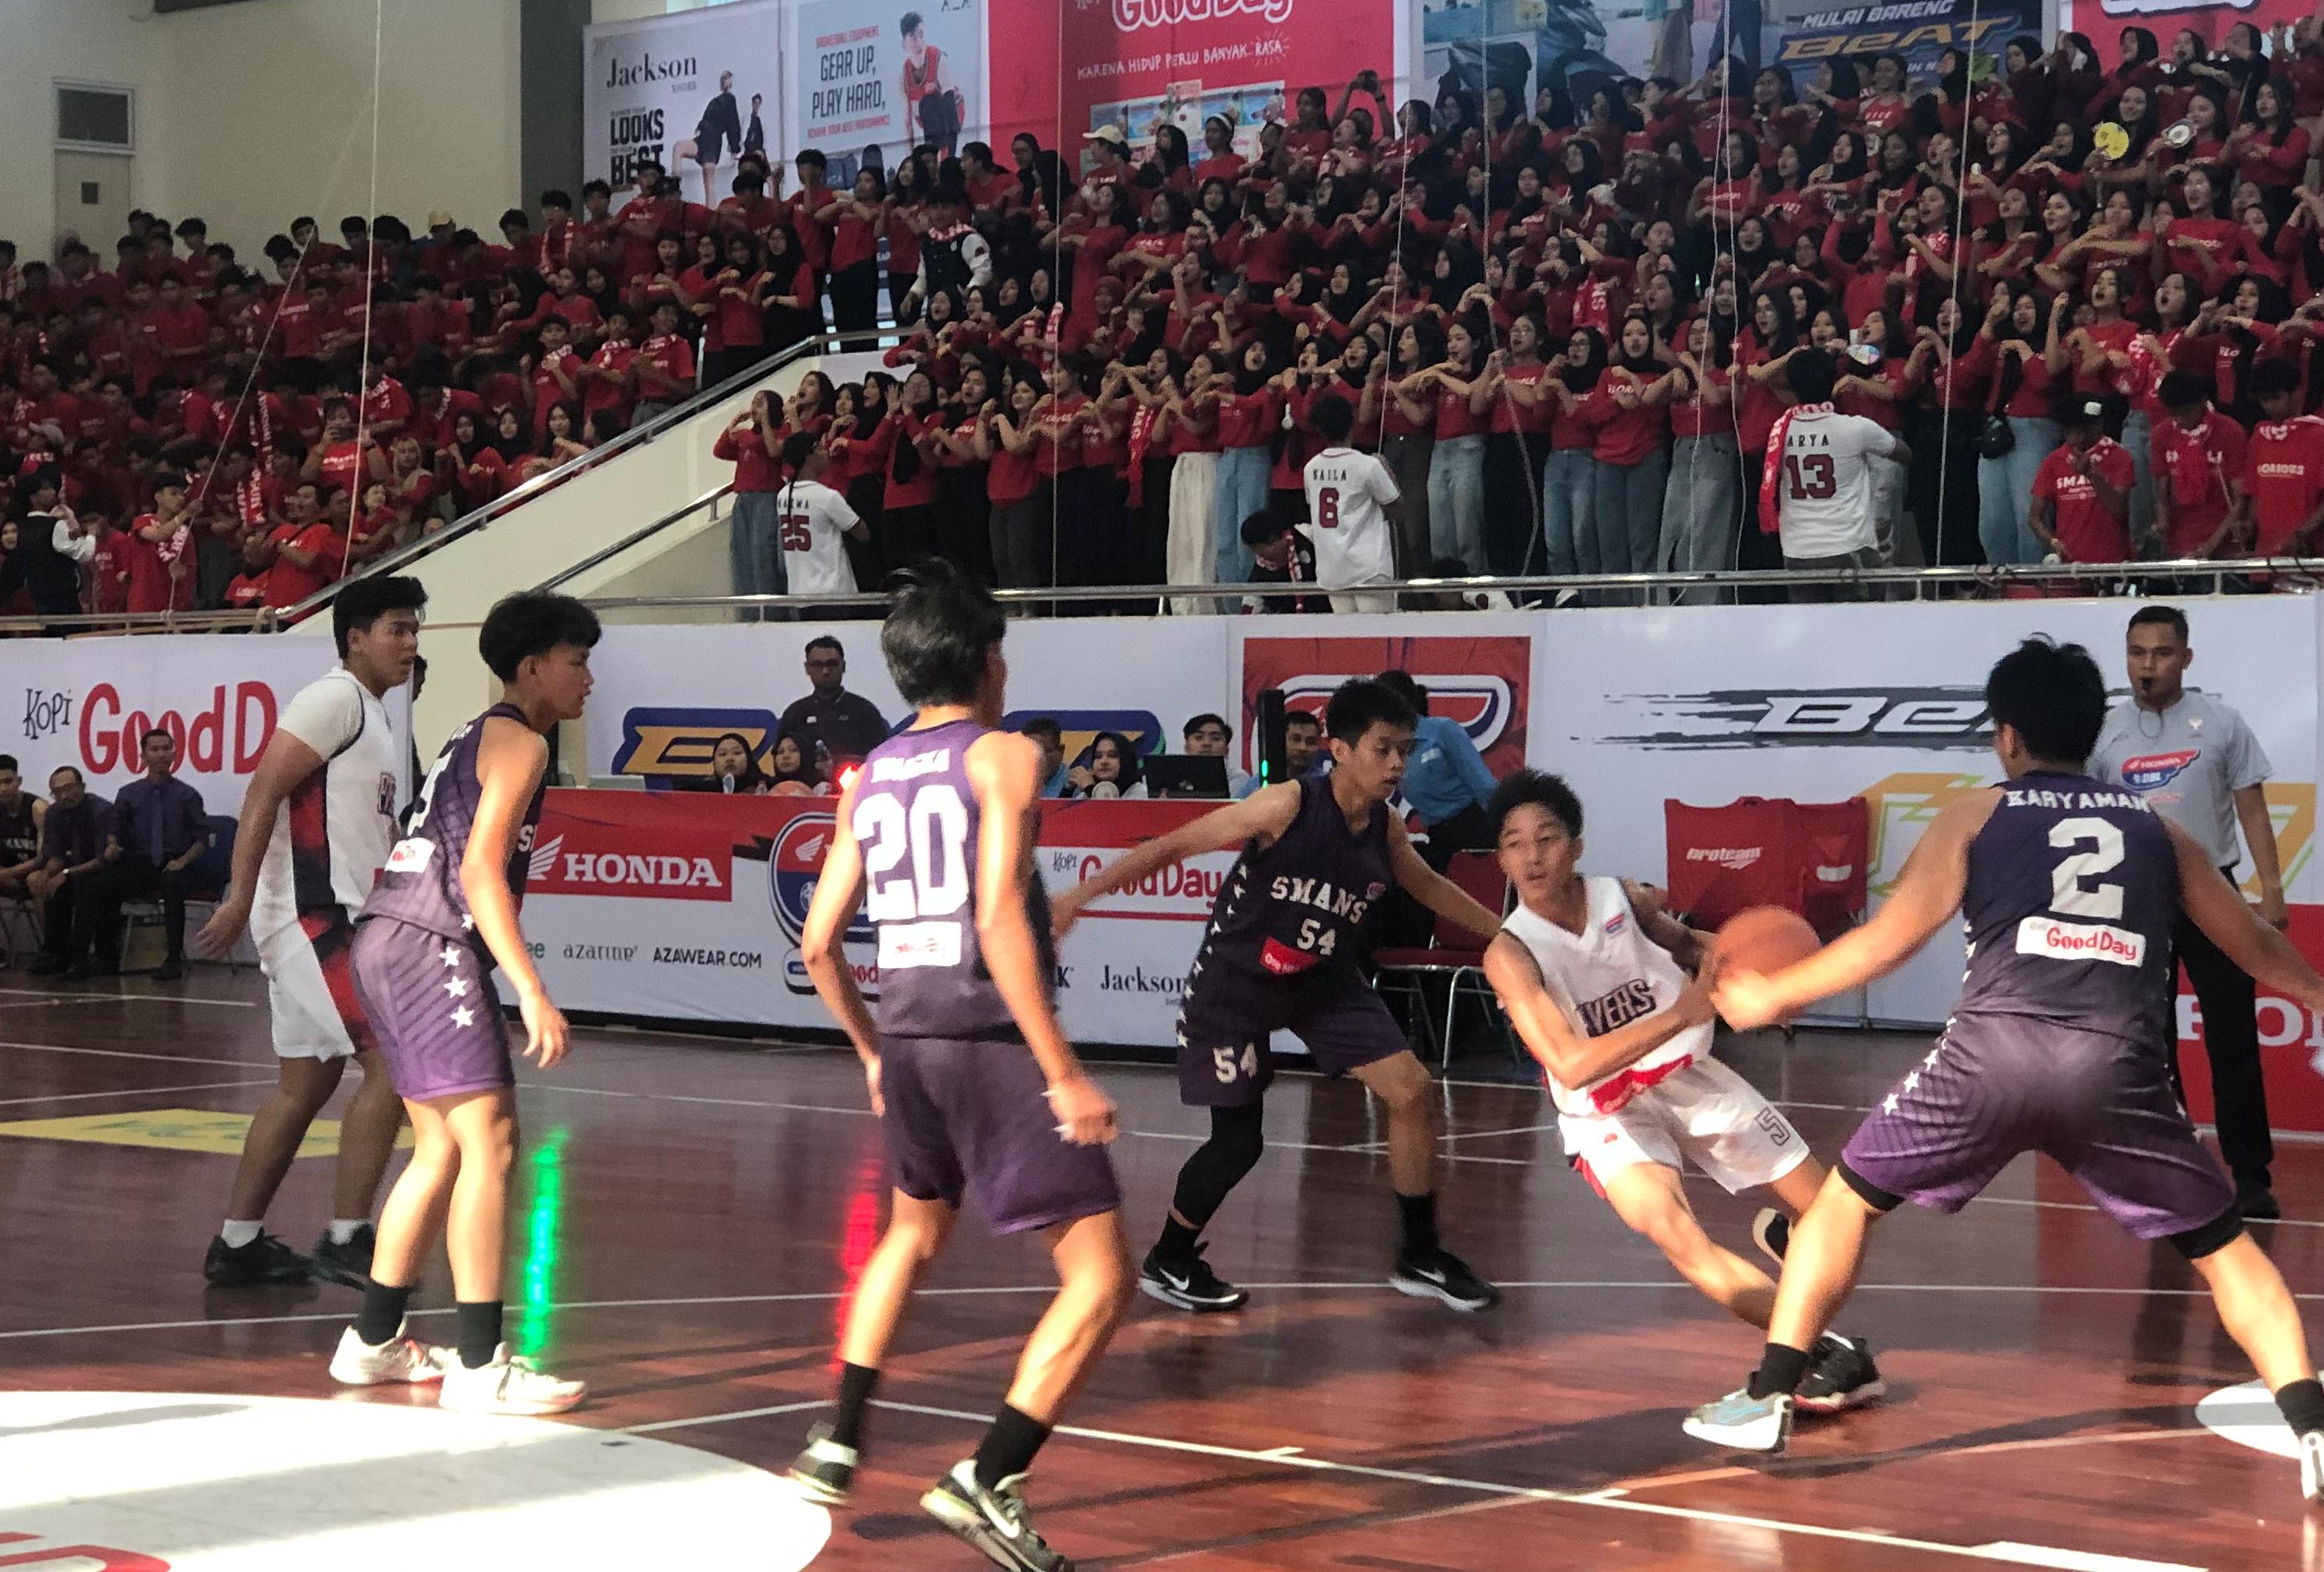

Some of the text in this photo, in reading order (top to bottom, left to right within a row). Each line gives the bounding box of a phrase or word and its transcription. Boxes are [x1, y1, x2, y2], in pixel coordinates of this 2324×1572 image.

[1801, 0, 1954, 29] MULAI BARENG
[606, 53, 698, 88] Jackson
[820, 44, 876, 81] GEAR UP,
[1077, 40, 1284, 79] KARENA HIDUP PERLU BANYAK RASA
[812, 80, 887, 119] PLAY HARD,
[610, 108, 664, 146] LOOKS
[1787, 434, 1830, 447] ARYA
[1785, 453, 1837, 500] 13
[1319, 487, 1339, 528] 6
[780, 514, 812, 552] 25
[563, 852, 723, 887] HONDA
[852, 784, 969, 922] 20
[2048, 817, 2125, 920] 2
[1270, 875, 1368, 924] SMANS
[1296, 918, 1337, 956] 54
[1212, 1042, 1260, 1084] 54
[1755, 1106, 1791, 1147] 5
